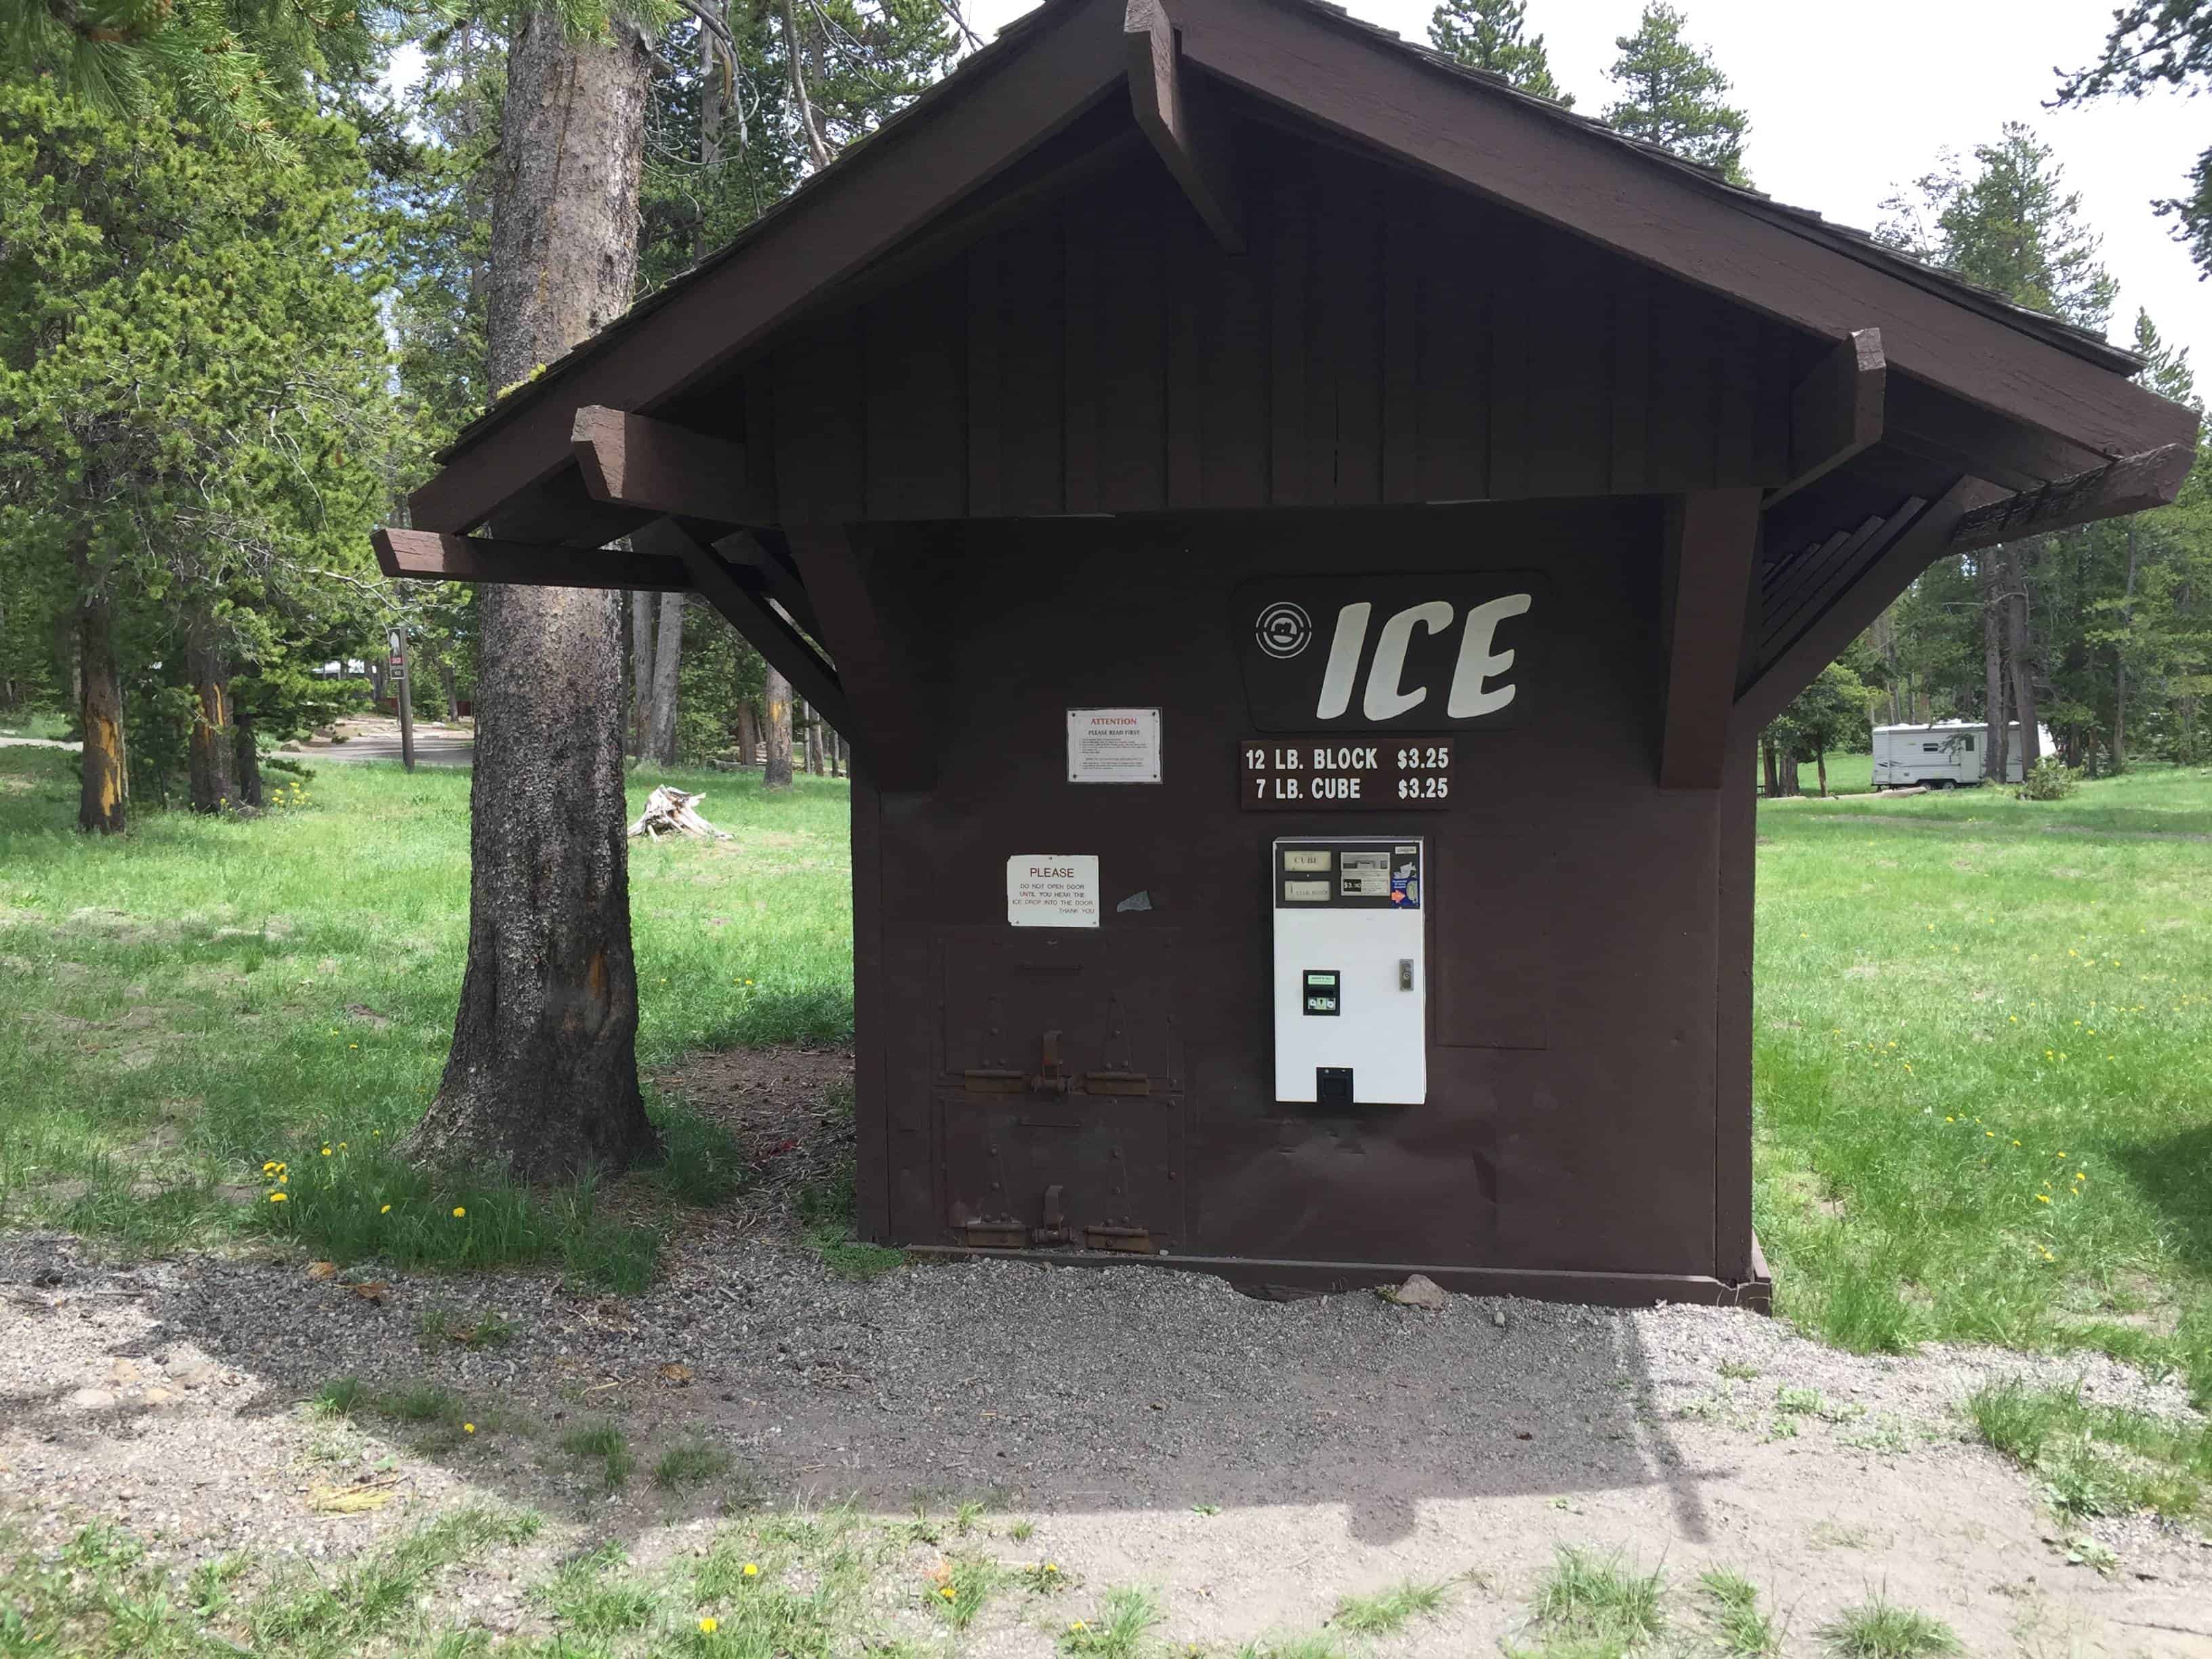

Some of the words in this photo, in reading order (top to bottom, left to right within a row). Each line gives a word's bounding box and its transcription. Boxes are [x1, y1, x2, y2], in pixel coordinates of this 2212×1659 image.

[1316, 594, 1532, 721] ICE
[1246, 749, 1265, 769] 12
[1275, 749, 1304, 769] LB.
[1313, 748, 1378, 769] BLOCK
[1397, 748, 1449, 770] $3.25
[1256, 779, 1266, 798] 7
[1275, 779, 1303, 799] LB.
[1311, 777, 1361, 799] CUBE
[1397, 778, 1448, 800] $3.25
[1029, 867, 1074, 878] PLEASE
